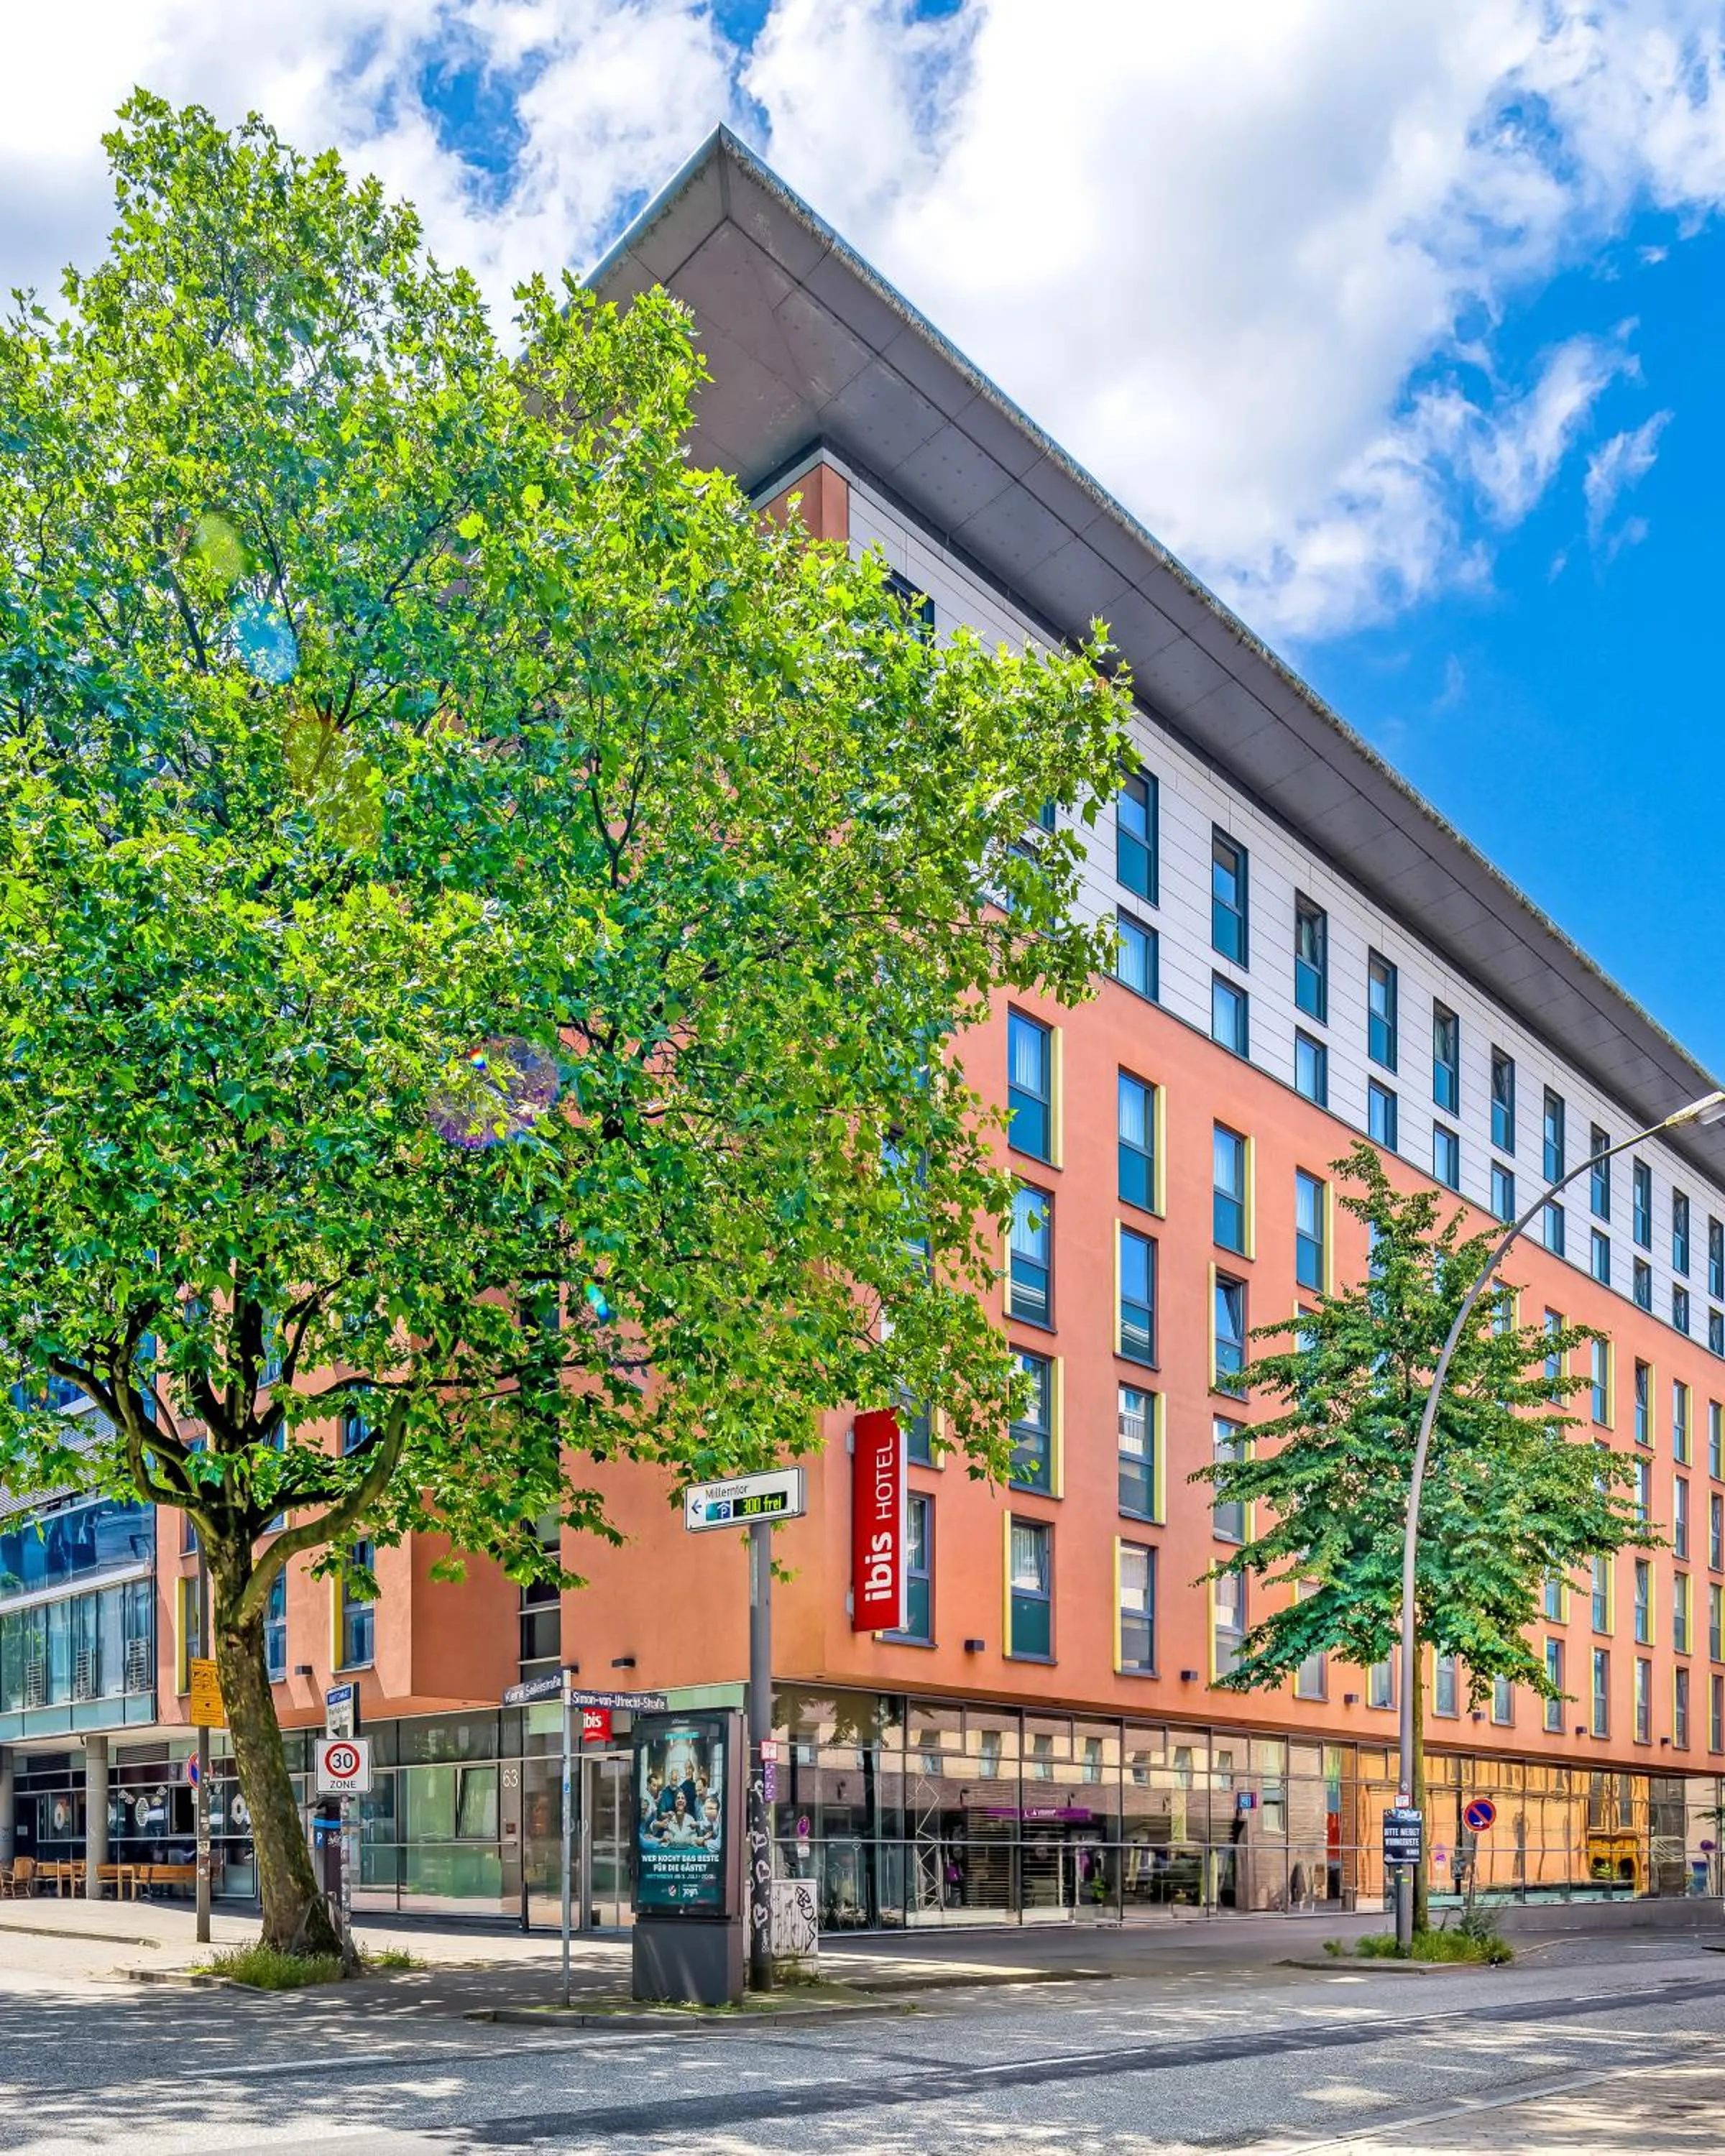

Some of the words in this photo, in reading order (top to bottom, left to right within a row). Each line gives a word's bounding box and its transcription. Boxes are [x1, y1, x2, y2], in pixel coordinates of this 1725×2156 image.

[875, 1437, 893, 1520] HOTEL
[705, 1485, 748, 1499] Millerntor
[743, 1497, 761, 1515] 300
[763, 1496, 782, 1511] frei
[865, 1531, 892, 1602] ibis
[573, 1692, 665, 1710] Simon-von-Utrecht-Straße
[583, 1712, 602, 1728] ibis
[333, 1753, 353, 1769] 30
[330, 1780, 356, 1789] ZONE
[503, 1769, 518, 1787] 63
[316, 1832, 323, 1843] P
[668, 1864, 679, 1872] DIE
